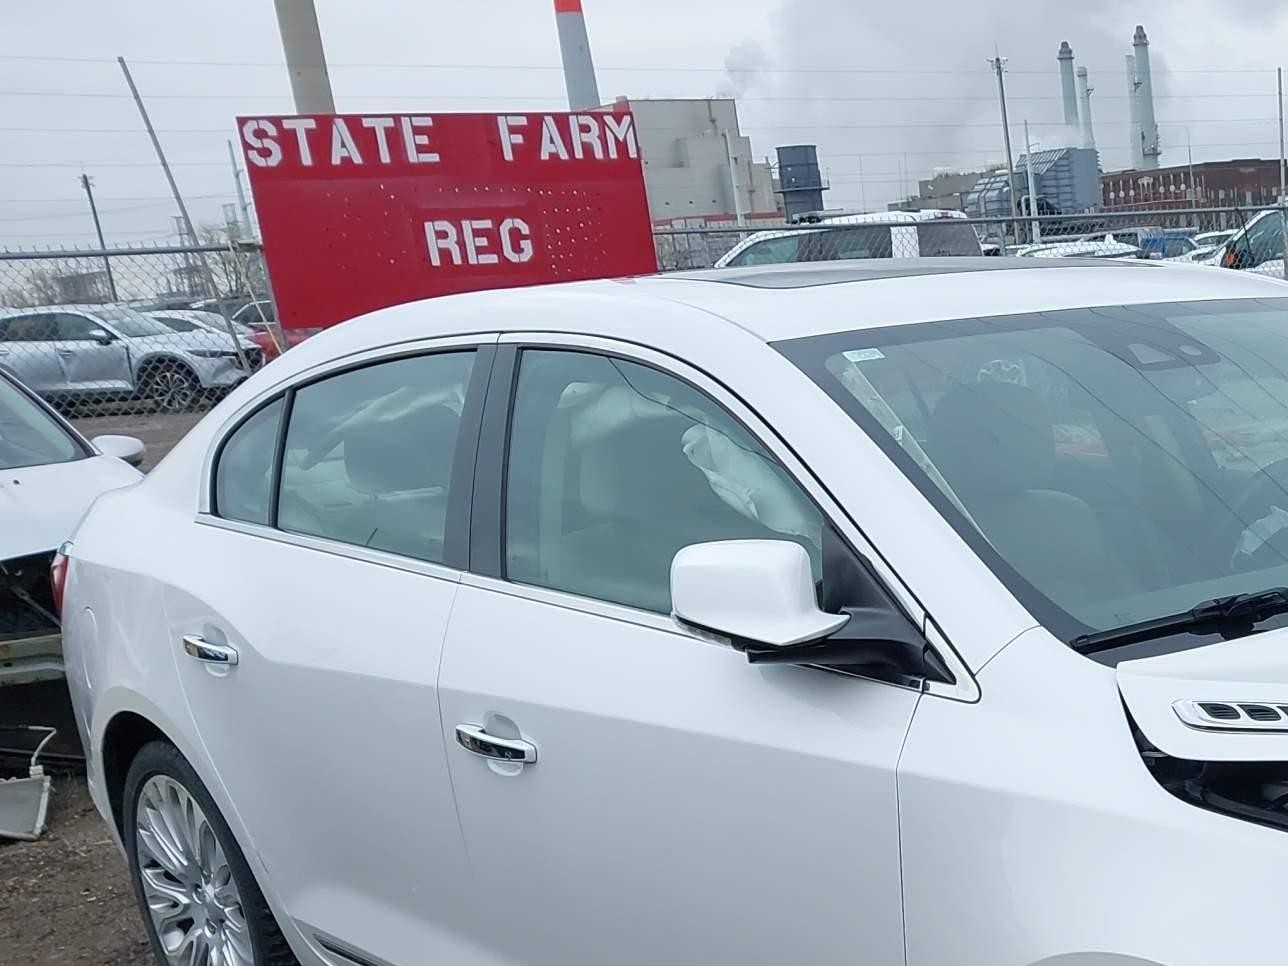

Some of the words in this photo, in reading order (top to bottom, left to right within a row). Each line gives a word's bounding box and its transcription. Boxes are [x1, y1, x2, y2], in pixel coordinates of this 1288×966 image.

[242, 116, 440, 167] STATE
[497, 115, 639, 161] FARM
[424, 218, 533, 266] REG
